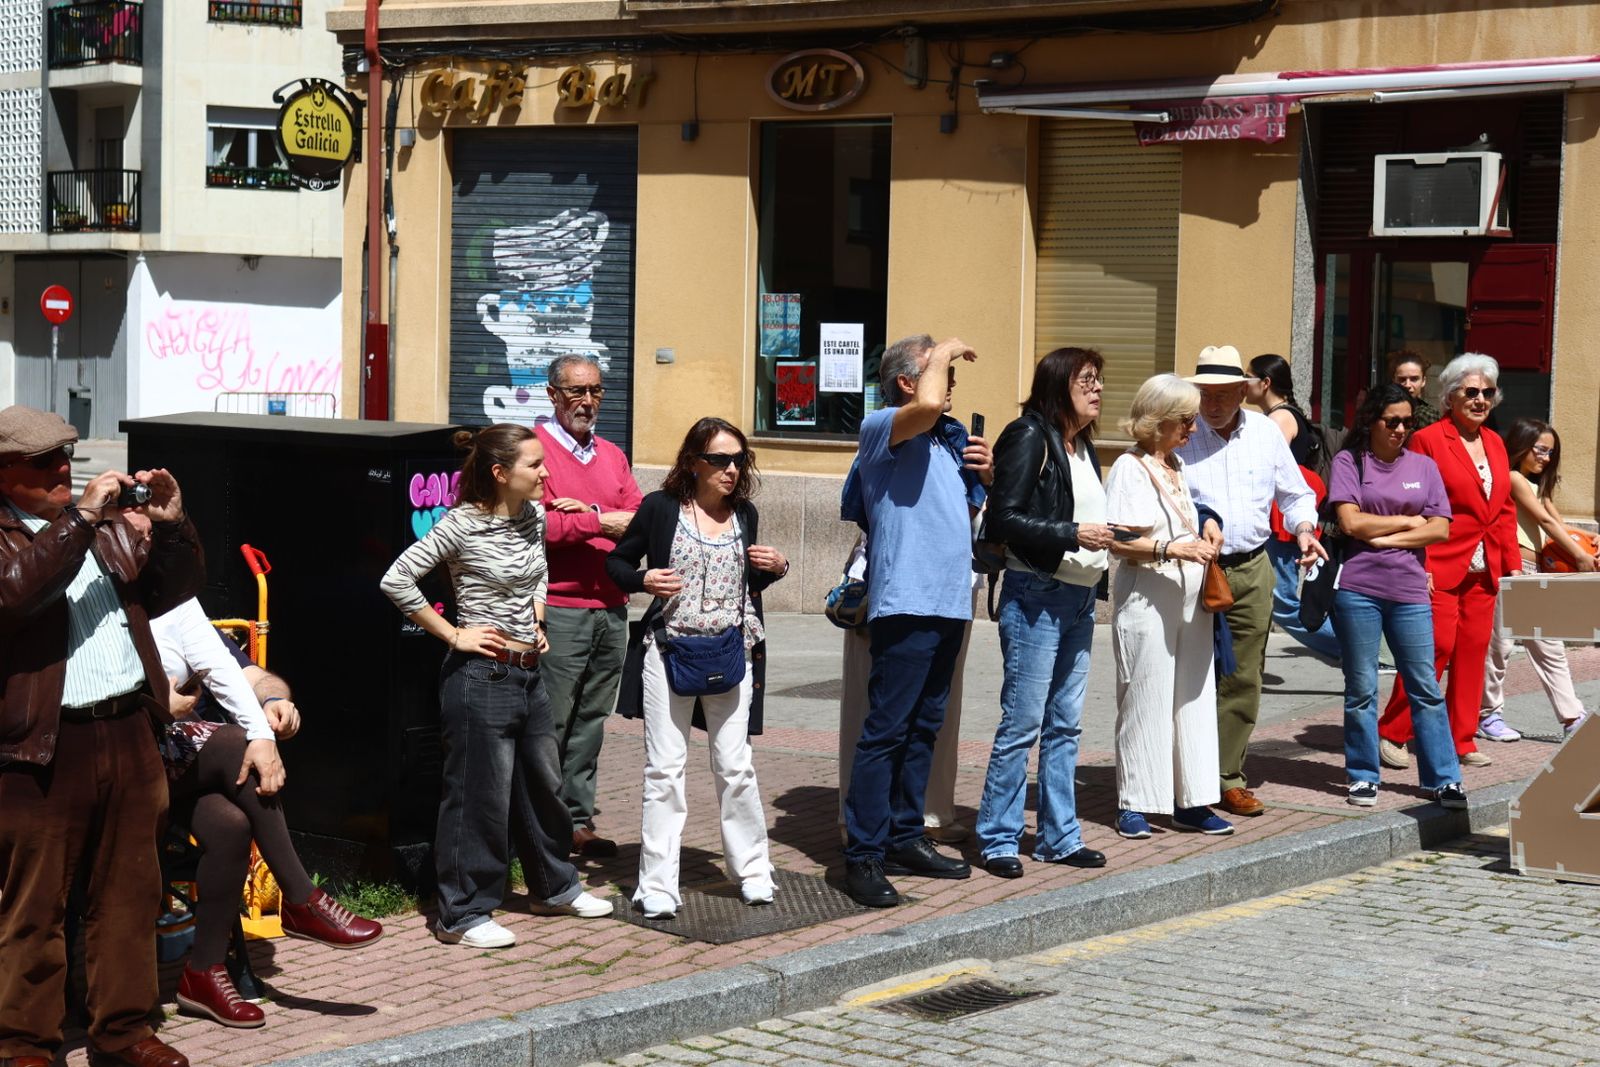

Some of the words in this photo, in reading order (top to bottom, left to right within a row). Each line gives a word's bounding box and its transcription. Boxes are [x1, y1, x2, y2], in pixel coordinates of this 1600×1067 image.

[781, 63, 847, 98] MT
[420, 63, 527, 122] Café
[557, 63, 658, 109] Bar
[294, 107, 342, 132] Estrella
[1171, 103, 1243, 120] BEBIDAS
[295, 129, 340, 153] Galicia
[1139, 124, 1241, 142] GOLOSINAS
[823, 340, 837, 348] ESTE
[838, 340, 860, 348] CARTEL
[823, 347, 831, 355] ES
[832, 347, 844, 355] UNA
[845, 347, 859, 355] IDEA
